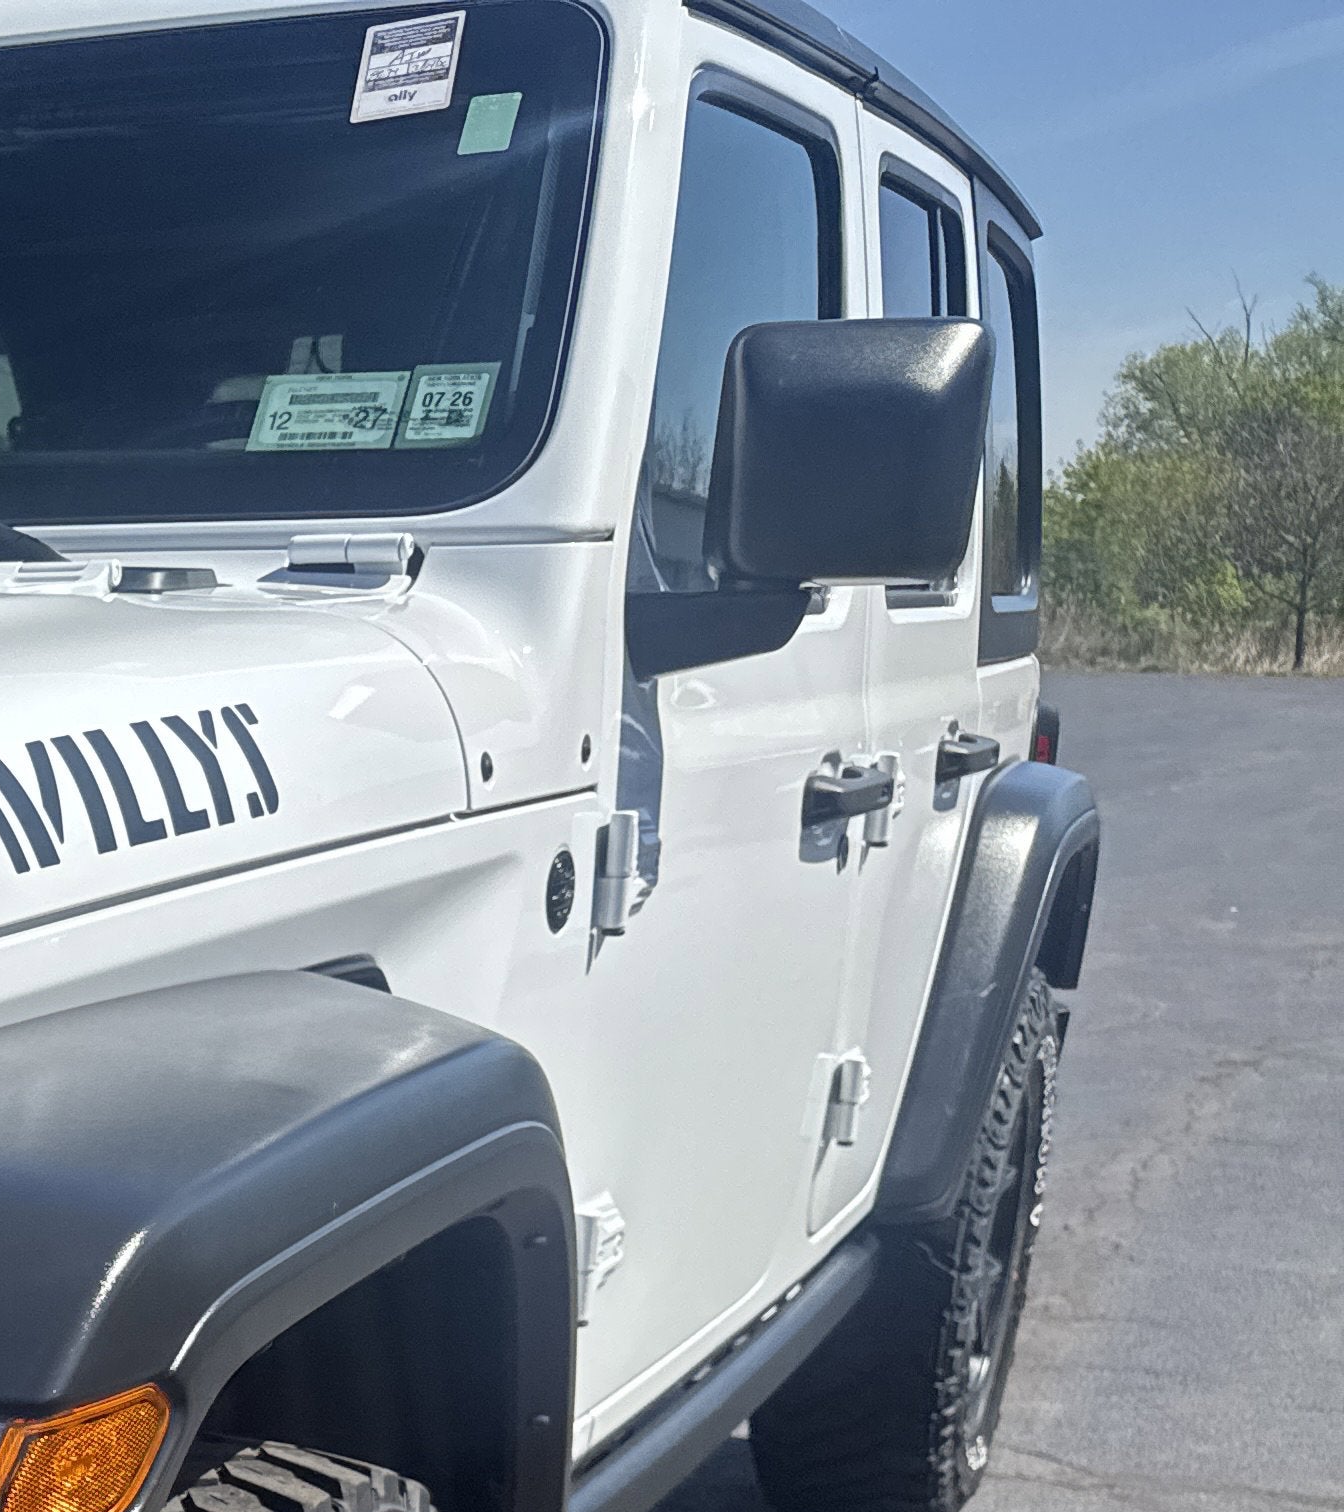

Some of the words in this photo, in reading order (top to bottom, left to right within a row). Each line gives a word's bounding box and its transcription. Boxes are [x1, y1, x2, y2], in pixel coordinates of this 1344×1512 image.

[388, 90, 417, 102] ally
[422, 391, 445, 407] 07
[450, 391, 474, 406] 26
[269, 411, 292, 431] 12
[353, 408, 387, 430] 27
